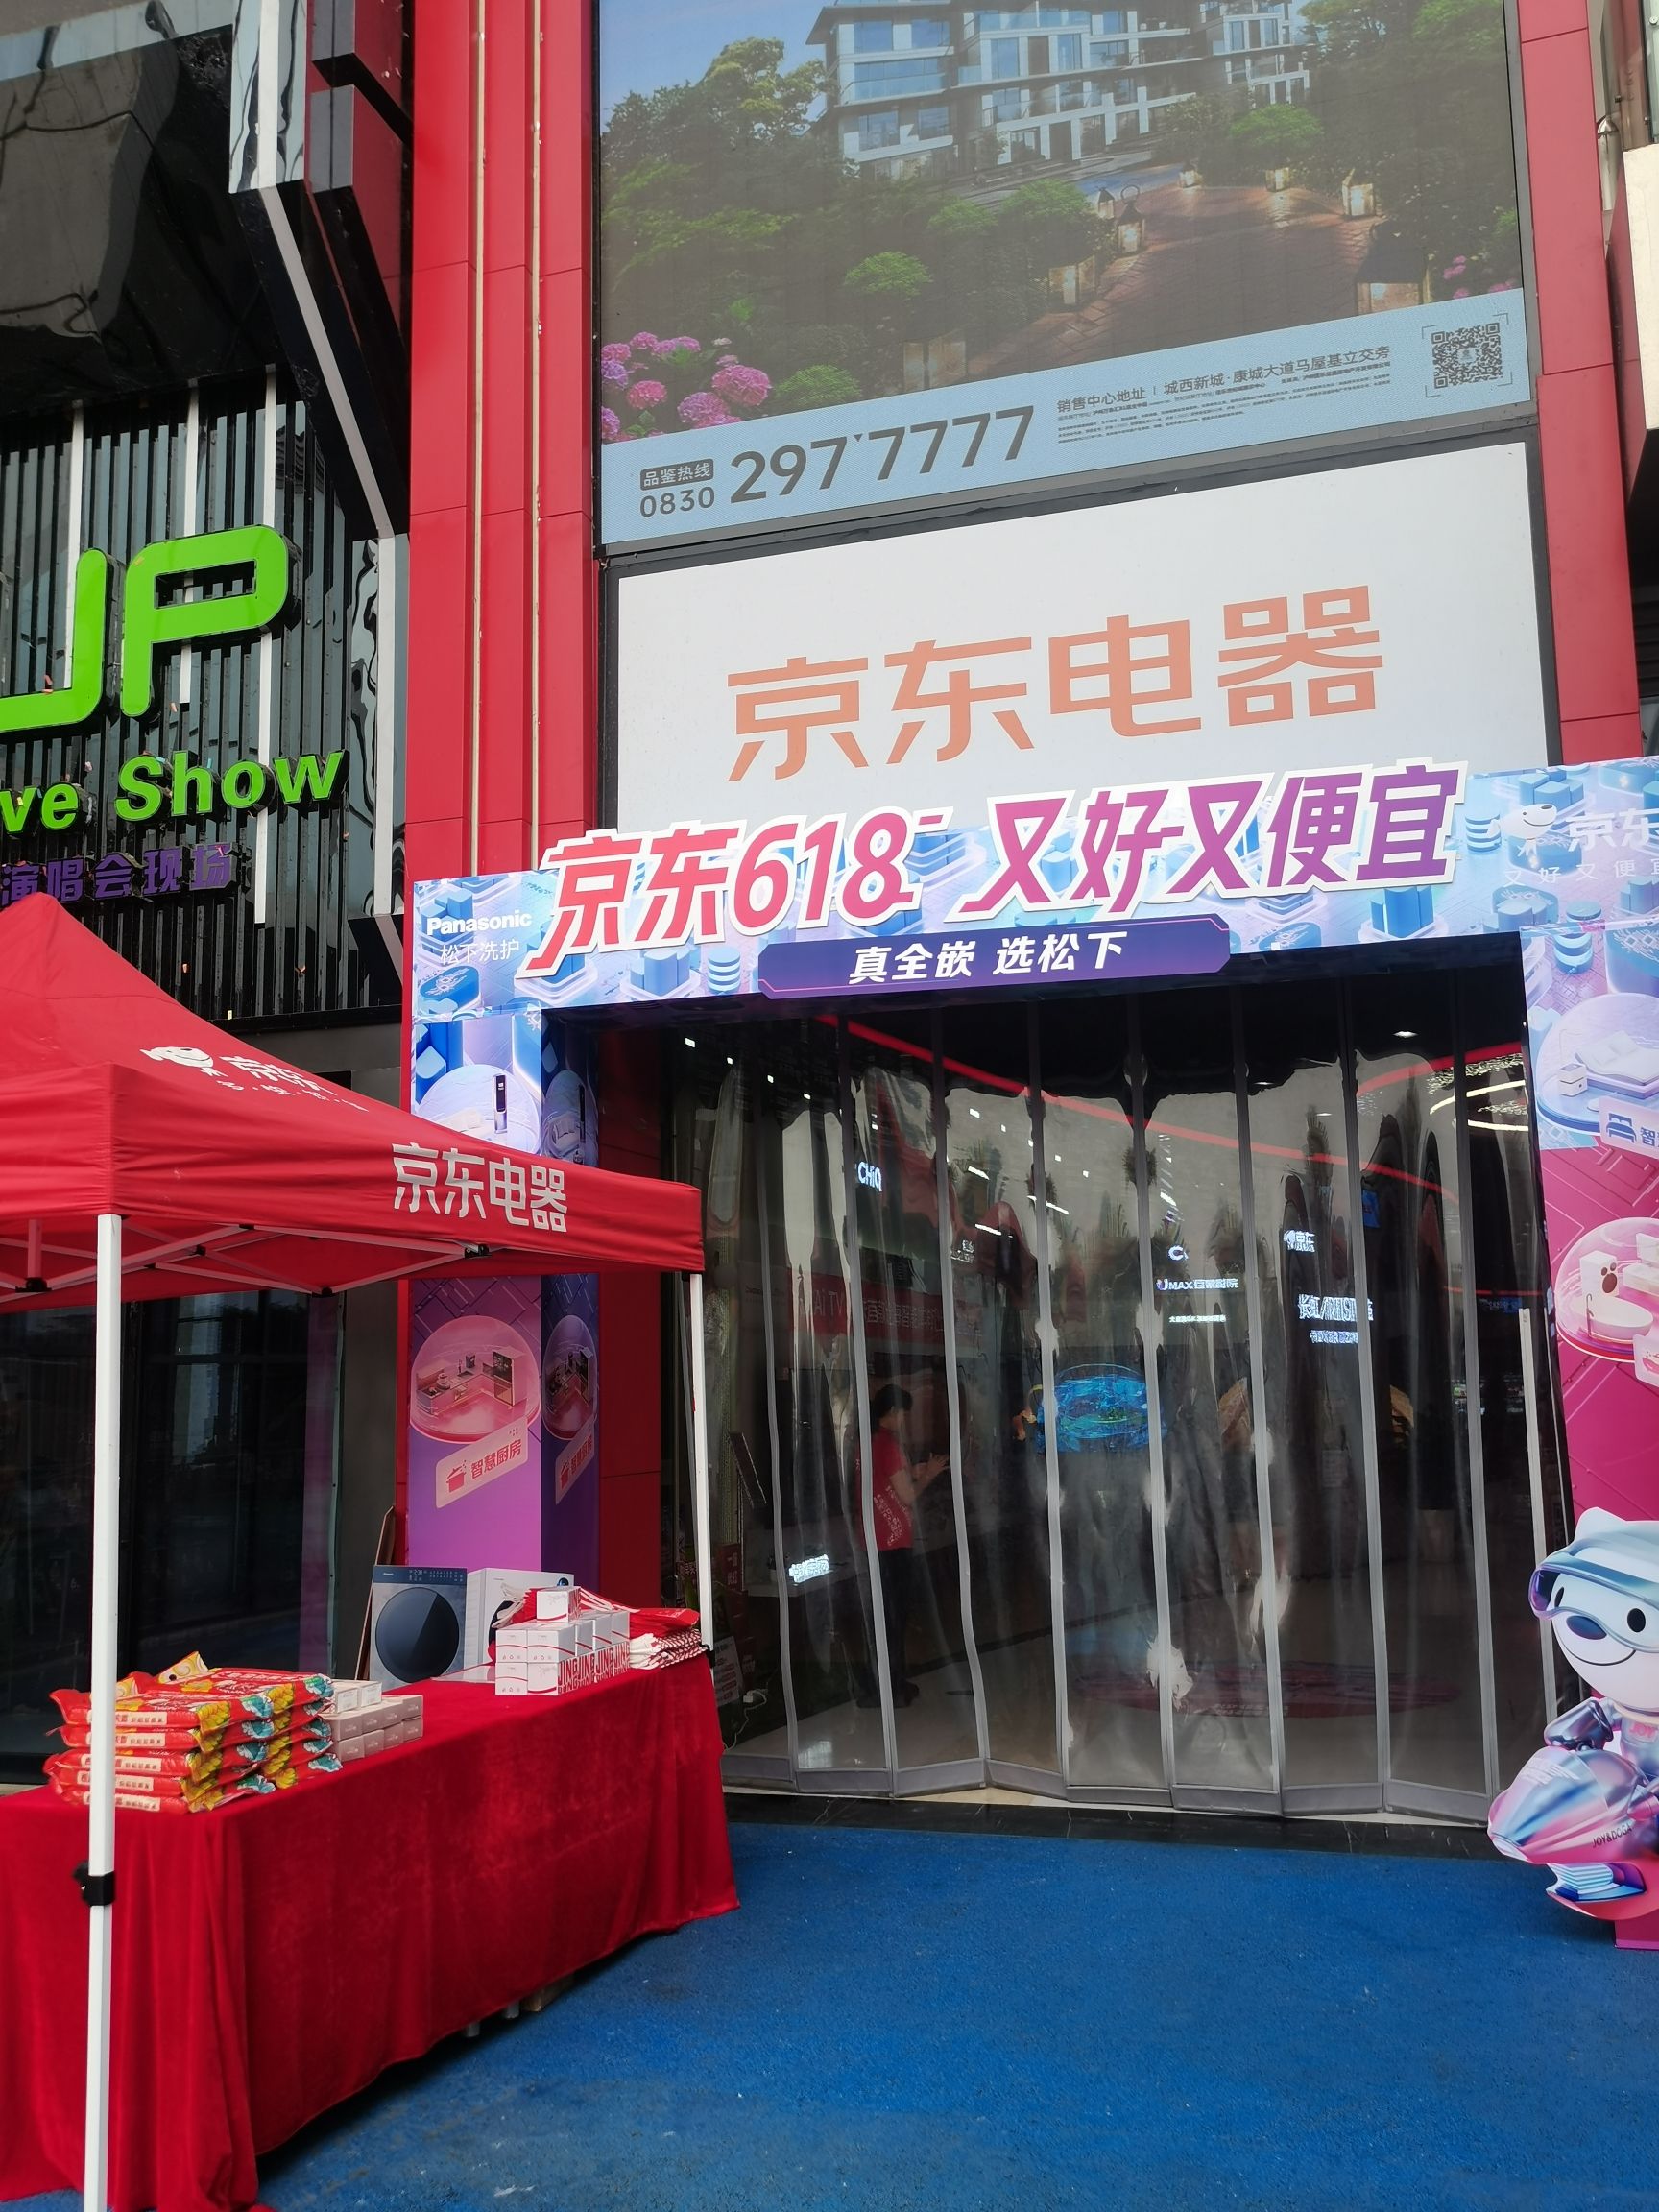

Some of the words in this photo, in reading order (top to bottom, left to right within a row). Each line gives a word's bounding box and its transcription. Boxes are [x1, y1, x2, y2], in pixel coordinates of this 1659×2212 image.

[1056, 387, 1146, 413] 销售中心地址
[643, 462, 711, 488] 品鉴热线
[640, 486, 715, 517] 0830
[728, 585, 1383, 781] 京东电器
[114, 749, 343, 823] Show
[523, 814, 924, 973] 京东618
[956, 762, 1462, 914] 又好又便宜
[426, 909, 533, 936] Panasonic
[440, 939, 520, 965] 松下洗护
[849, 939, 976, 985] 真全嵌
[992, 931, 1128, 976] 选松下
[391, 1142, 567, 1233] 京东电器
[470, 1438, 522, 1480] 智慧厨房
[1629, 1721, 1656, 1739] JOY
